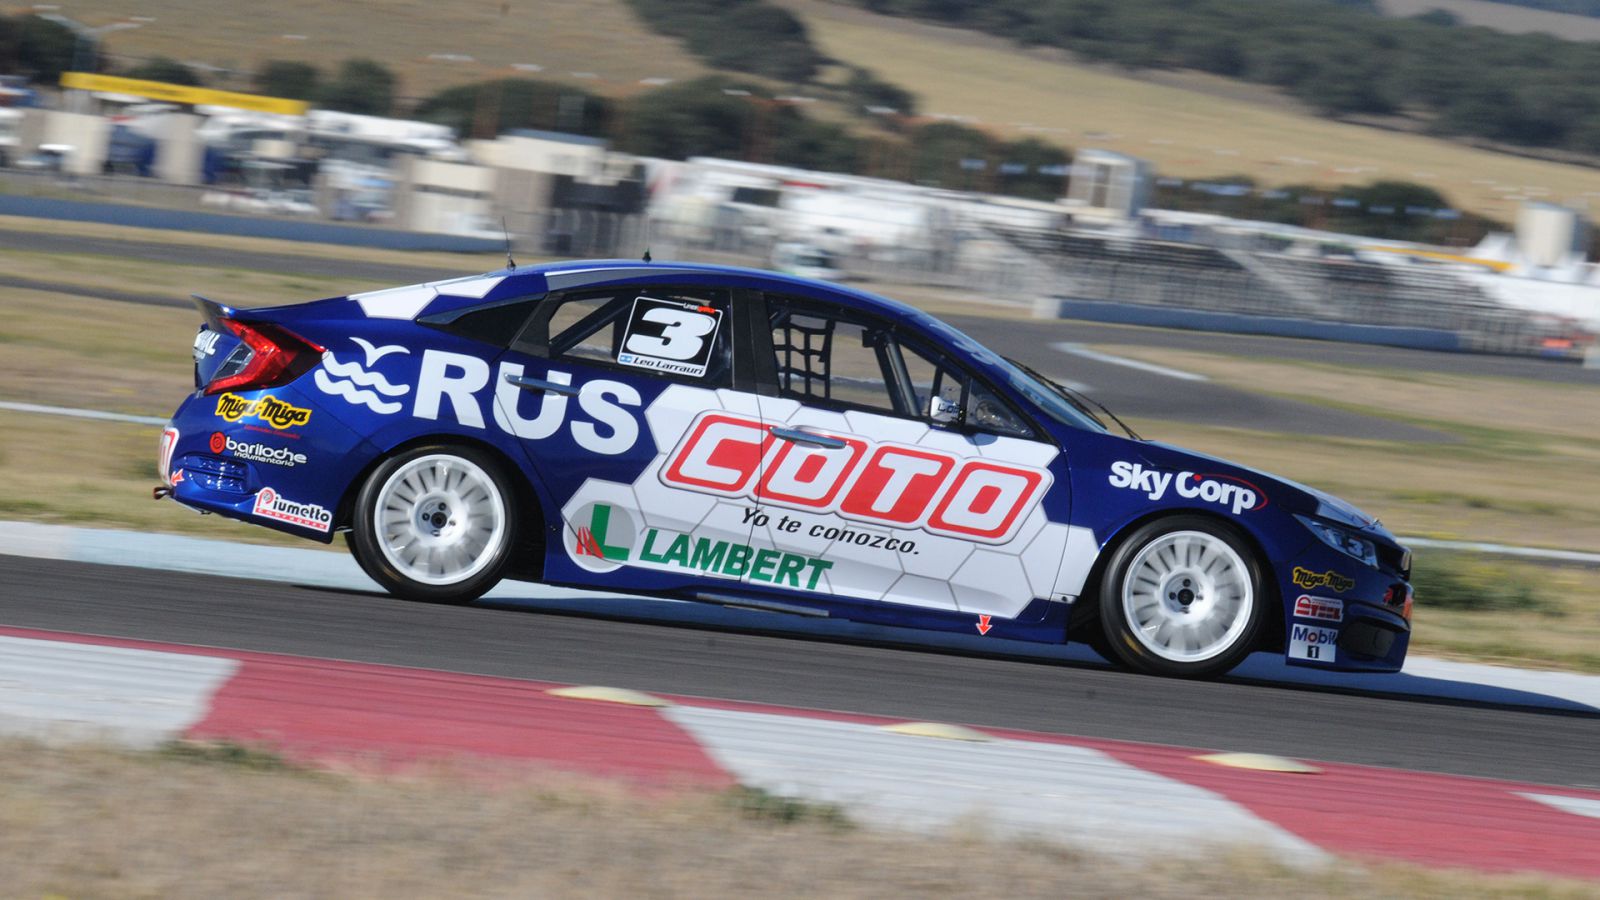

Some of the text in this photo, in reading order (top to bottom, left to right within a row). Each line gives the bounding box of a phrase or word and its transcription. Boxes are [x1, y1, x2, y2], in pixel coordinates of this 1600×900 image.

[626, 308, 716, 360] 3
[633, 357, 704, 375] Leo Larrauri
[412, 349, 641, 454] RUS
[226, 436, 307, 464] bariloche
[676, 419, 1030, 533] COTO
[1109, 461, 1256, 515] Sky Corp
[257, 489, 330, 522] Piumetto
[742, 508, 919, 555] Yo te conozco.
[639, 528, 834, 590] LAMBERT
[1293, 626, 1337, 645] Mobil
[1308, 646, 1318, 658] 1
